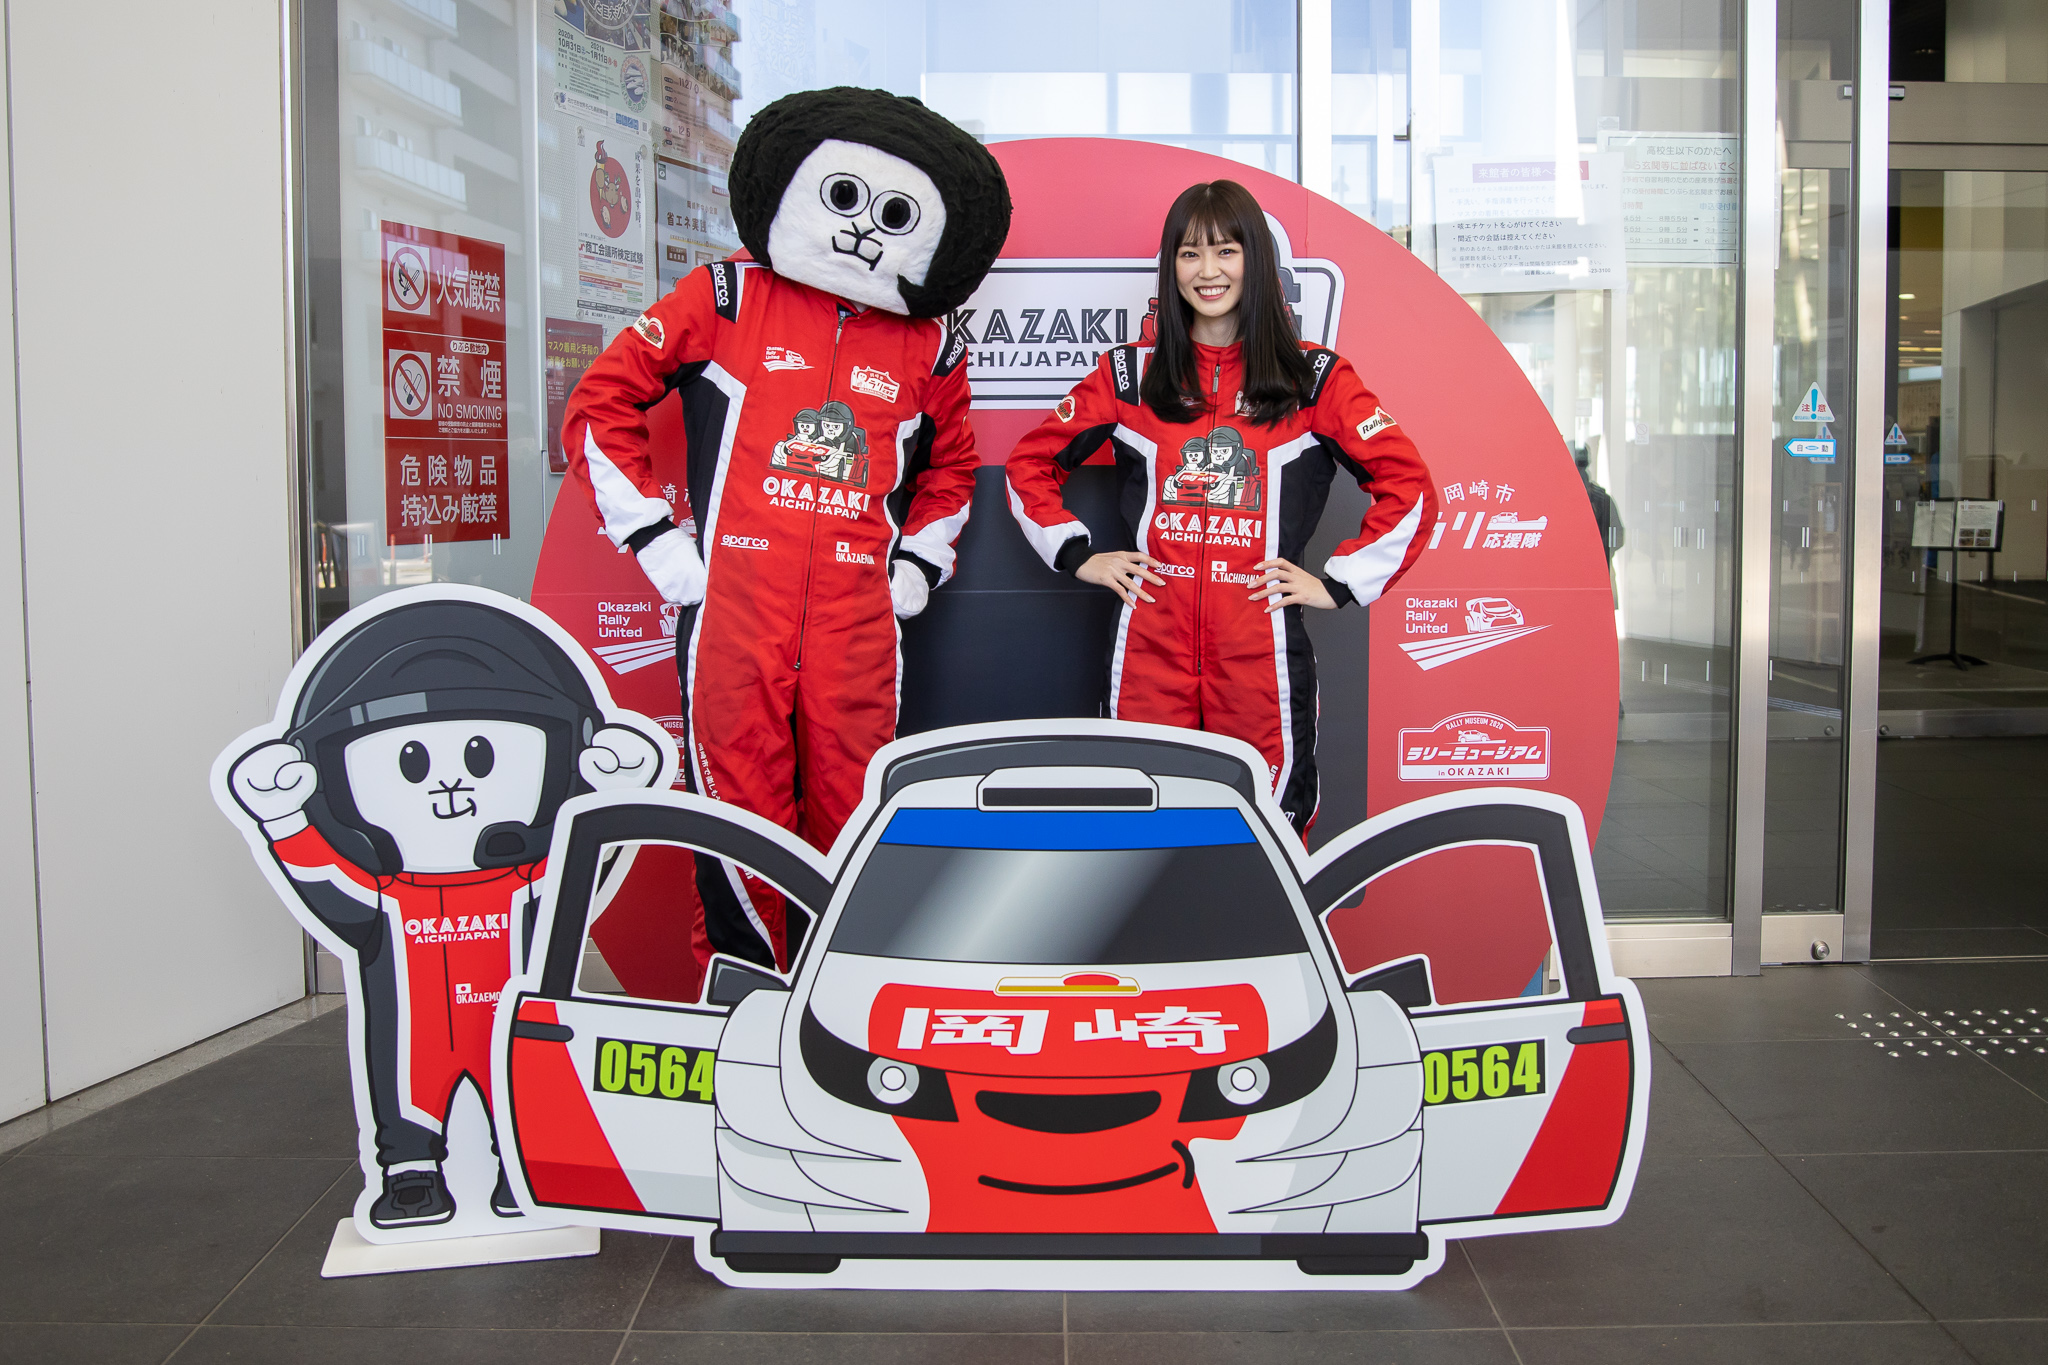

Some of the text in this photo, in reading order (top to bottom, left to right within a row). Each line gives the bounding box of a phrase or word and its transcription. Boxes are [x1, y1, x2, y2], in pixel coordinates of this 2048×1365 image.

[1646, 145, 1732, 156] 高校生以下のかたへ
[436, 264, 501, 313] 火気厳禁
[946, 309, 1129, 344] KAZAKI
[437, 403, 502, 420] NO SMOKING
[400, 454, 497, 486] 危険物品
[763, 476, 871, 512] OKAZAKI
[1443, 479, 1516, 504] 岡崎市
[401, 493, 498, 527] 持込み厳禁
[769, 497, 860, 520] AICHI/JAPAN
[1155, 511, 1263, 539] OKAZAKI
[1482, 532, 1543, 549] 応援隊
[598, 601, 652, 612] Okazaki
[1405, 597, 1458, 609] Okazaki
[598, 614, 631, 627] Rally
[1405, 610, 1437, 623] Rally
[599, 626, 643, 638] United
[1405, 623, 1448, 634] United
[1446, 717, 1504, 731] RALLY MUSEUM 2020
[1406, 745, 1543, 761] ラリーミュージアム
[1447, 767, 1510, 776] OKAZAKI
[404, 913, 509, 936] OKAZAKI
[414, 930, 500, 944] AICHI/JAPAN
[455, 991, 501, 1005] OKAZAEMO
[897, 1006, 1239, 1055] 岡崎
[600, 1040, 1541, 1104] 0564 0564
